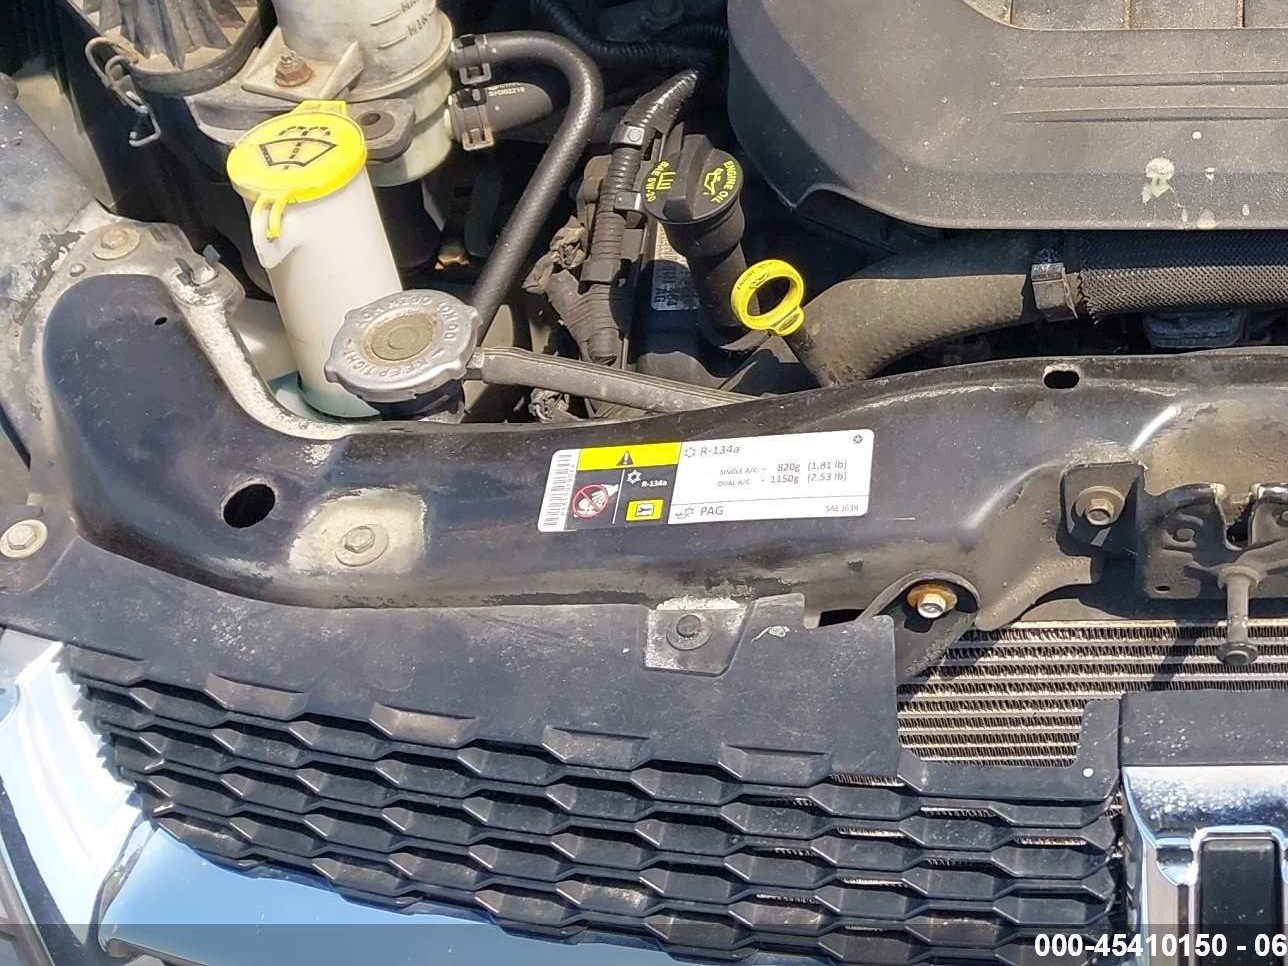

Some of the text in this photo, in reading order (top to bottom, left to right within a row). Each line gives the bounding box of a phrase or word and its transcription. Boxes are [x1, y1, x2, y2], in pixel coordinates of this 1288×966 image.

[710, 160, 737, 204] ENGINE OIL
[343, 350, 377, 376] TIGHT
[700, 445, 740, 457] R-134a
[720, 467, 743, 475] SINGLE
[777, 463, 800, 473] 820g
[807, 461, 831, 471] (1.81
[835, 460, 848, 470] lb)
[641, 479, 668, 489] R-134a
[738, 478, 750, 486] A/C
[771, 474, 800, 484] 1150g
[807, 472, 832, 483] (2.53
[835, 471, 848, 481] lb)
[700, 506, 724, 516] PAG
[842, 504, 859, 513] J639
